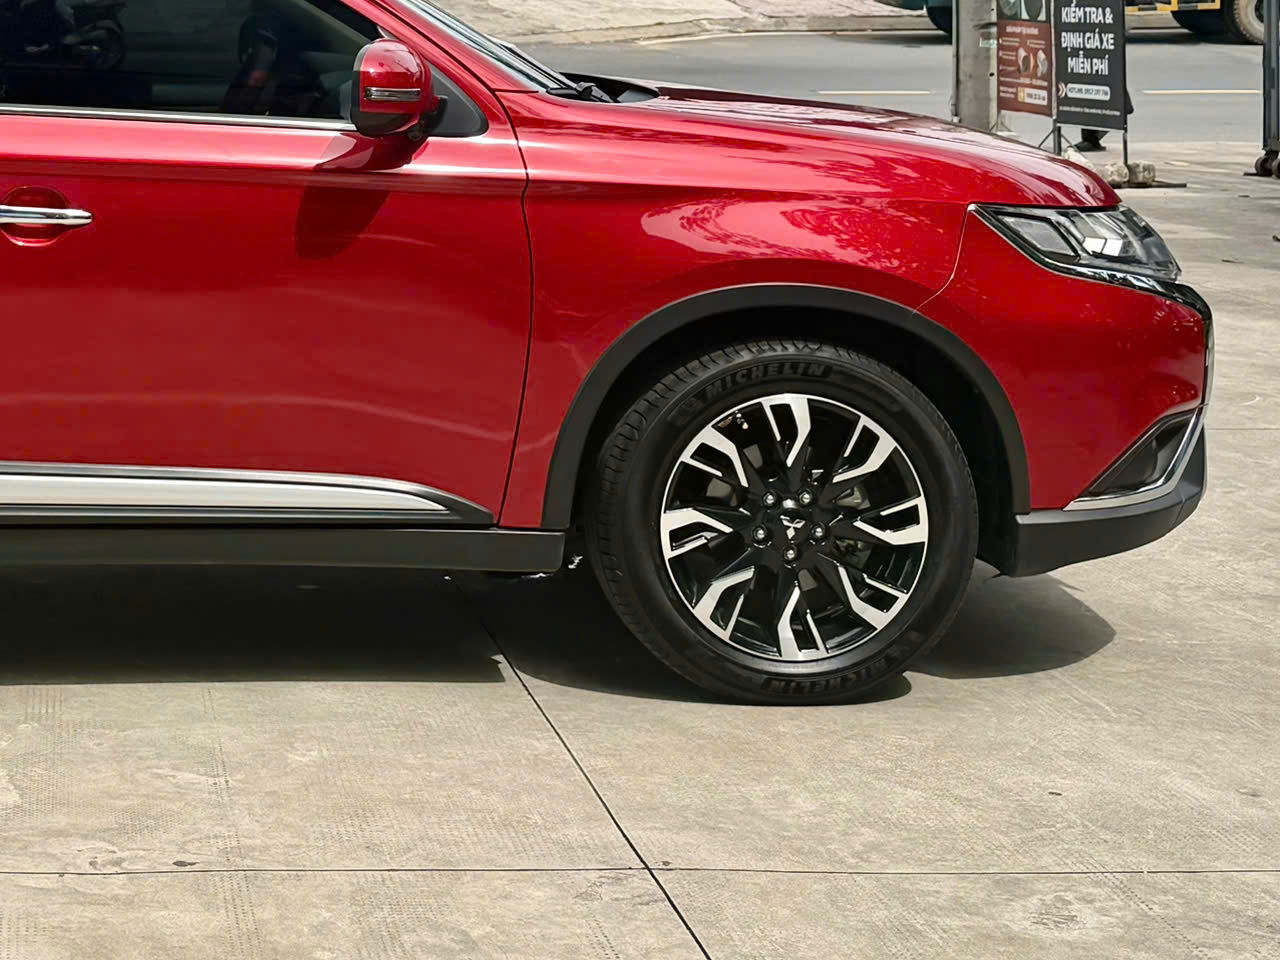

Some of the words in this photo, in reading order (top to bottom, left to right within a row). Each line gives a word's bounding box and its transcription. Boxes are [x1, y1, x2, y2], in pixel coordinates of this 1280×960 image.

[1061, 0, 1084, 23] KIỂM
[1085, 7, 1104, 24] TRA
[1105, 7, 1114, 24] &
[1061, 31, 1083, 52] ĐỊNH
[1084, 28, 1101, 49] GIÁ
[1101, 33, 1115, 50] XE
[1067, 50, 1091, 75] MIỄN
[1092, 54, 1109, 76] PHÍ
